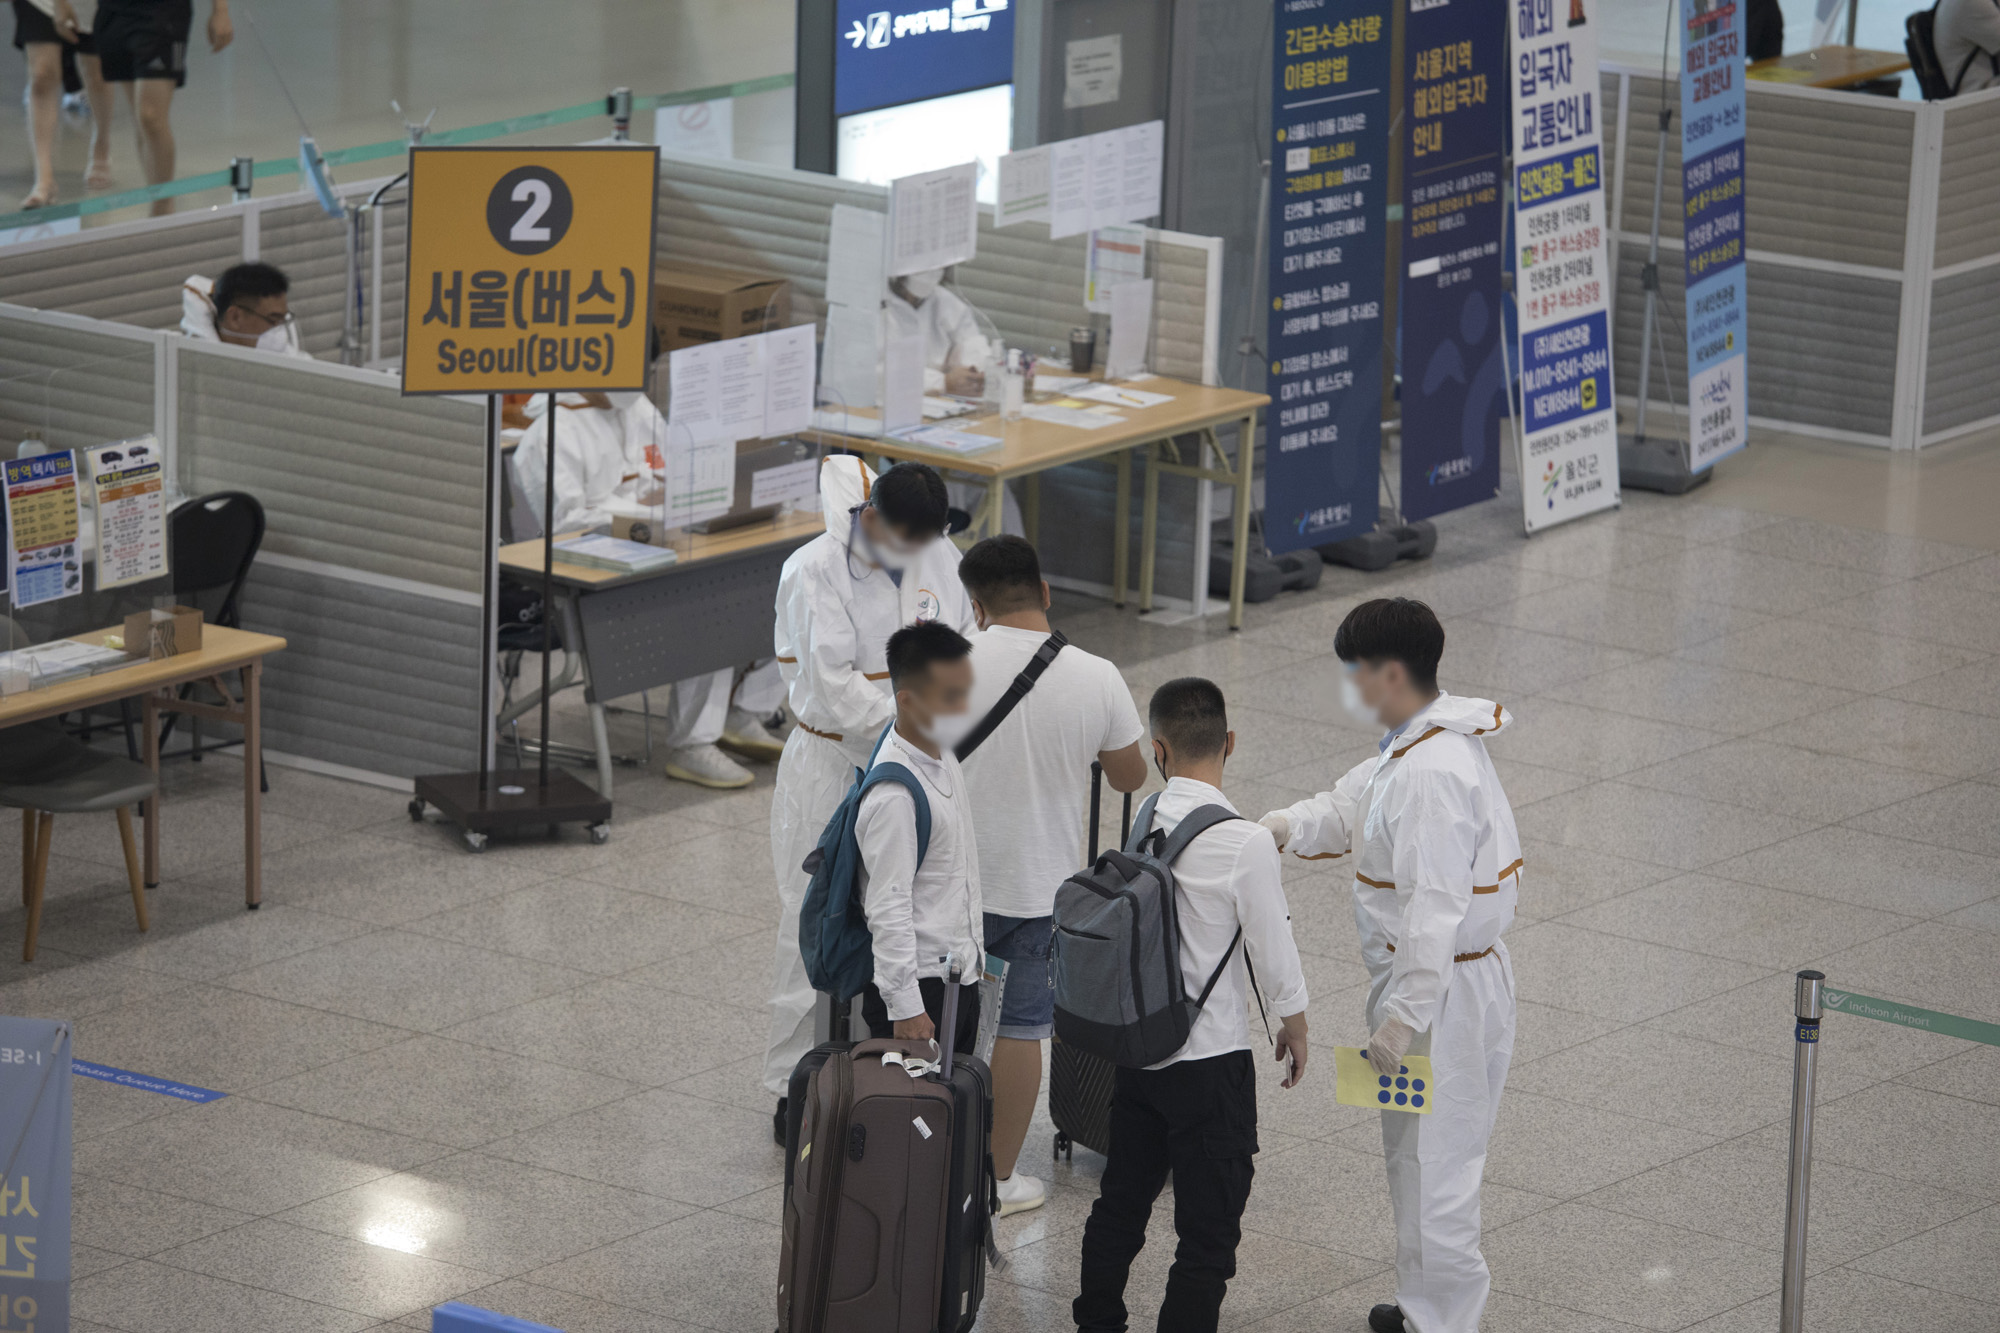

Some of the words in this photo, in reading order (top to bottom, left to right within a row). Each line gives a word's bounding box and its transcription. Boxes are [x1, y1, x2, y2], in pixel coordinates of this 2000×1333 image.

[1285, 14, 1382, 56] 긴급수송차량
[1707, 30, 1738, 66] 입국자
[1284, 55, 1348, 91] 이용방법
[1413, 39, 1473, 81] 서울지역
[1519, 41, 1573, 98] 입국자
[1413, 73, 1488, 119] 해외입국자
[1413, 120, 1443, 158] 안내
[1521, 92, 1593, 152] 교통안내
[509, 178, 553, 242] 2
[422, 266, 636, 330] 서울(버스)
[437, 332, 615, 378] Seoul(BUS)
[1799, 1028, 1819, 1041] E138
[1848, 1000, 1890, 1018] Incheon
[1892, 1010, 1931, 1027] Airport
[115, 1074, 167, 1091] Queue
[167, 1085, 206, 1100] Here
